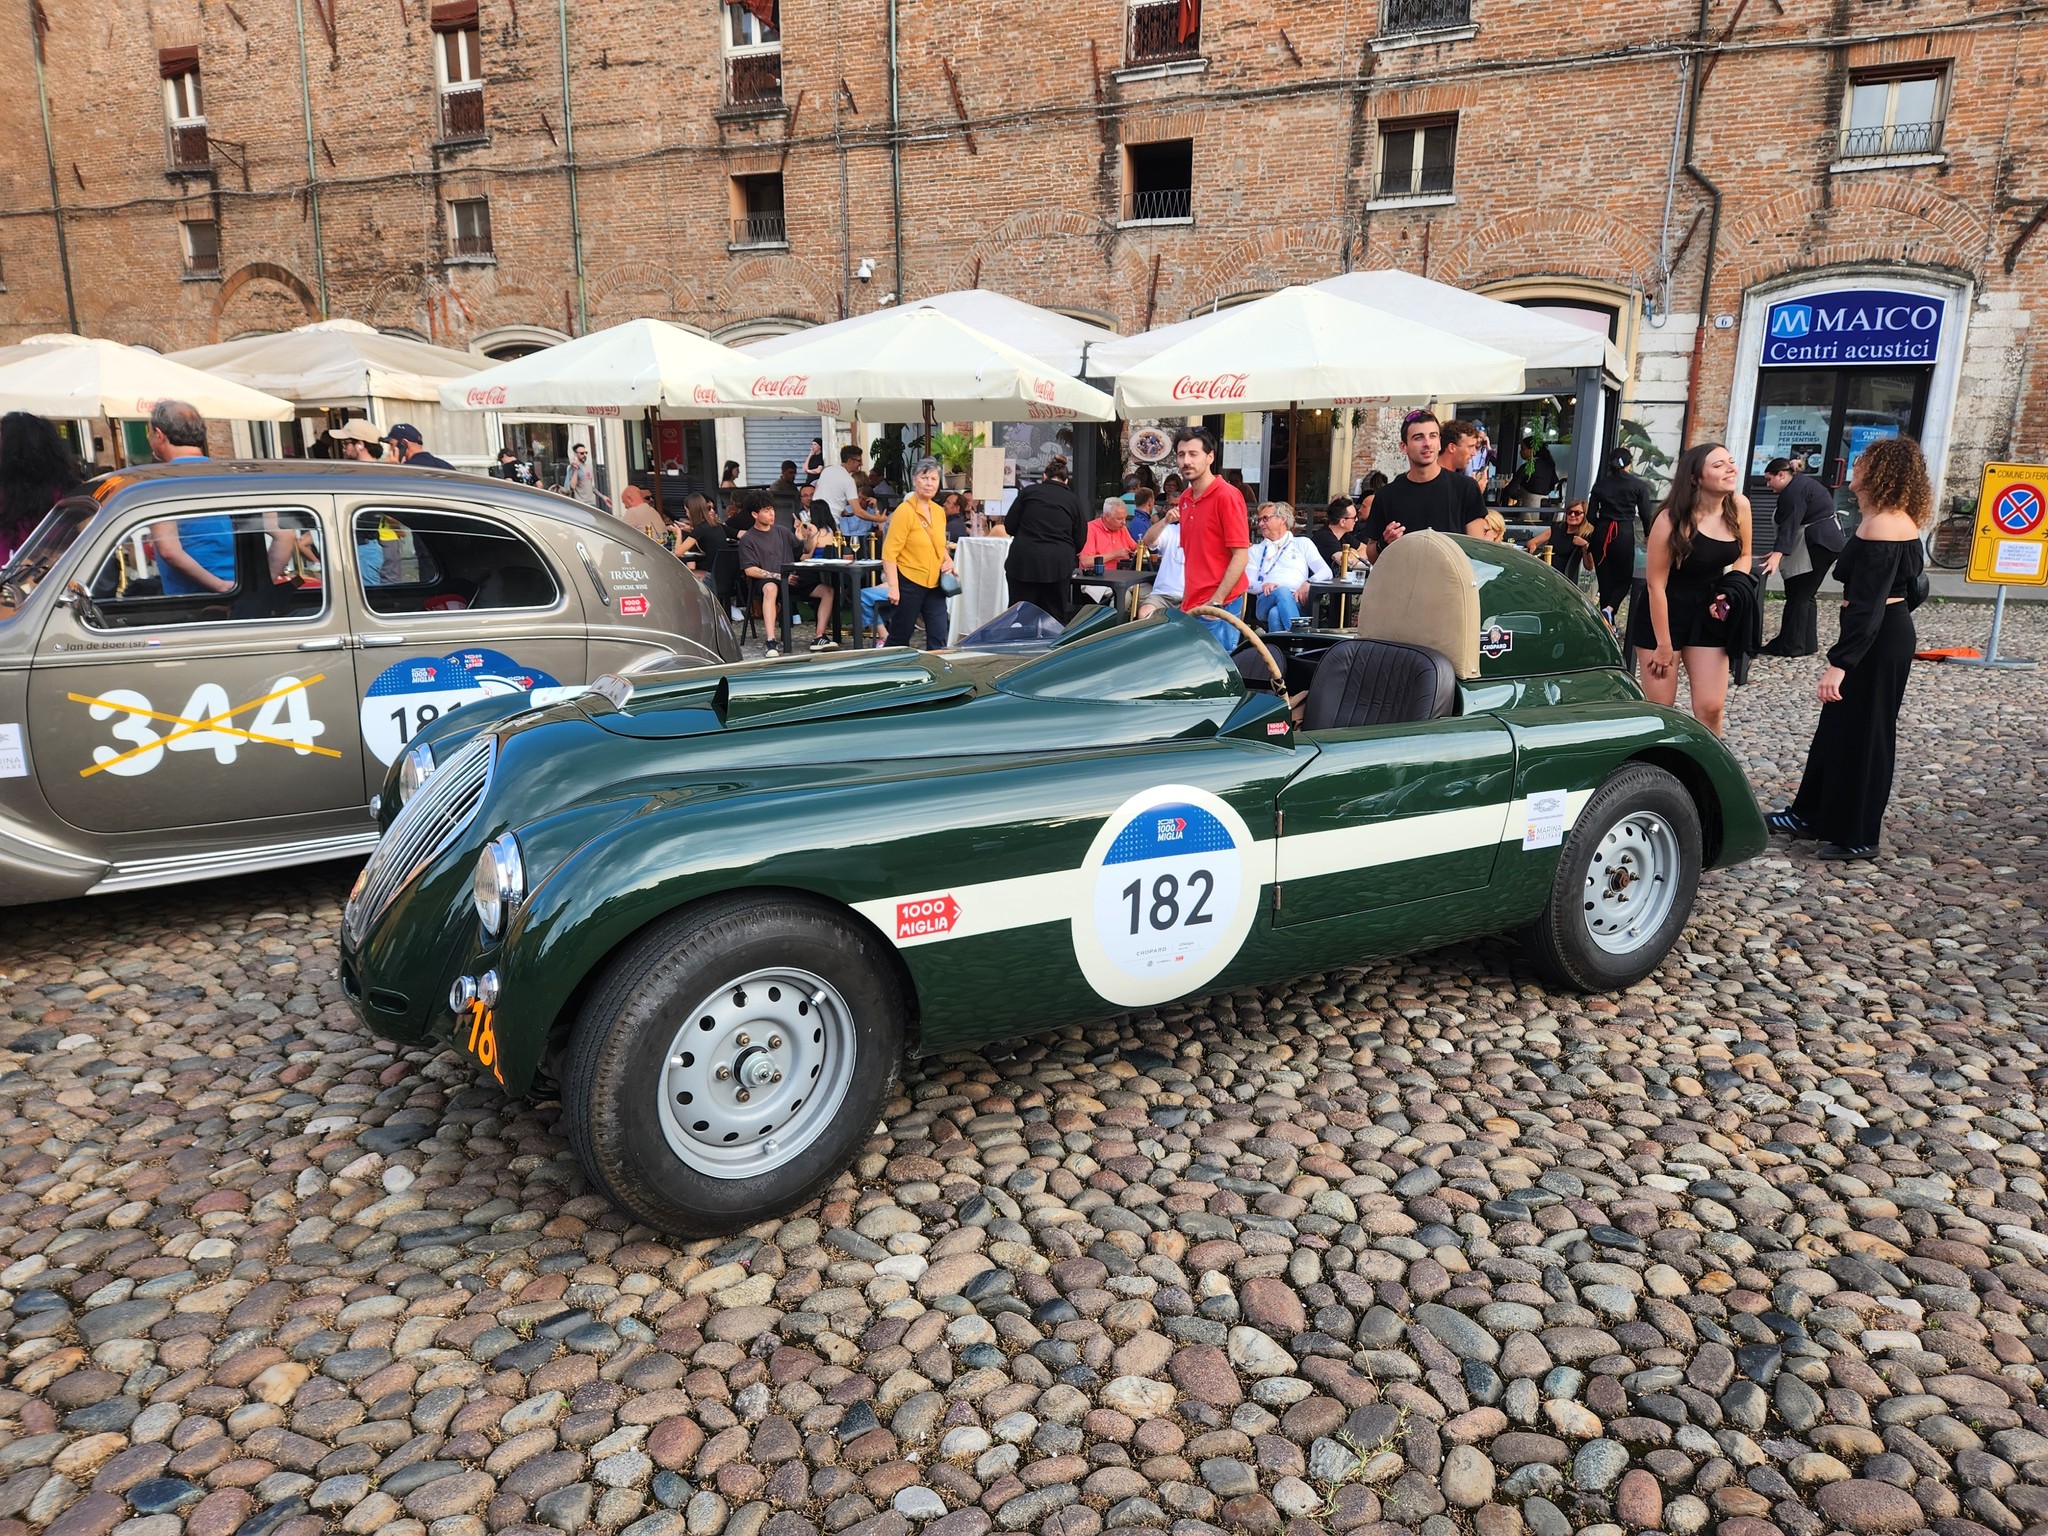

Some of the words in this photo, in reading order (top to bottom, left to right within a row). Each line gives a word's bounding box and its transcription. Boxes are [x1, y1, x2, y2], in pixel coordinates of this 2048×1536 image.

[1721, 318, 1727, 327] 6
[1814, 305, 1937, 332] MAICO
[1770, 341, 1838, 361] Centri
[1845, 339, 1930, 359] acustici
[1997, 470, 2025, 479] COMUNE
[2025, 472, 2033, 480] DI
[610, 570, 649, 581] TRASQUA
[86, 642, 99, 650] de
[89, 676, 325, 776] 344
[1157, 824, 1175, 833] 1000
[1537, 824, 1562, 835] MARINA
[1157, 831, 1183, 841] MIGLIA
[1122, 869, 1214, 935] 182
[902, 901, 945, 919] 1000
[899, 916, 948, 936] MIGLIA
[1136, 947, 1167, 956] CHOPARD
